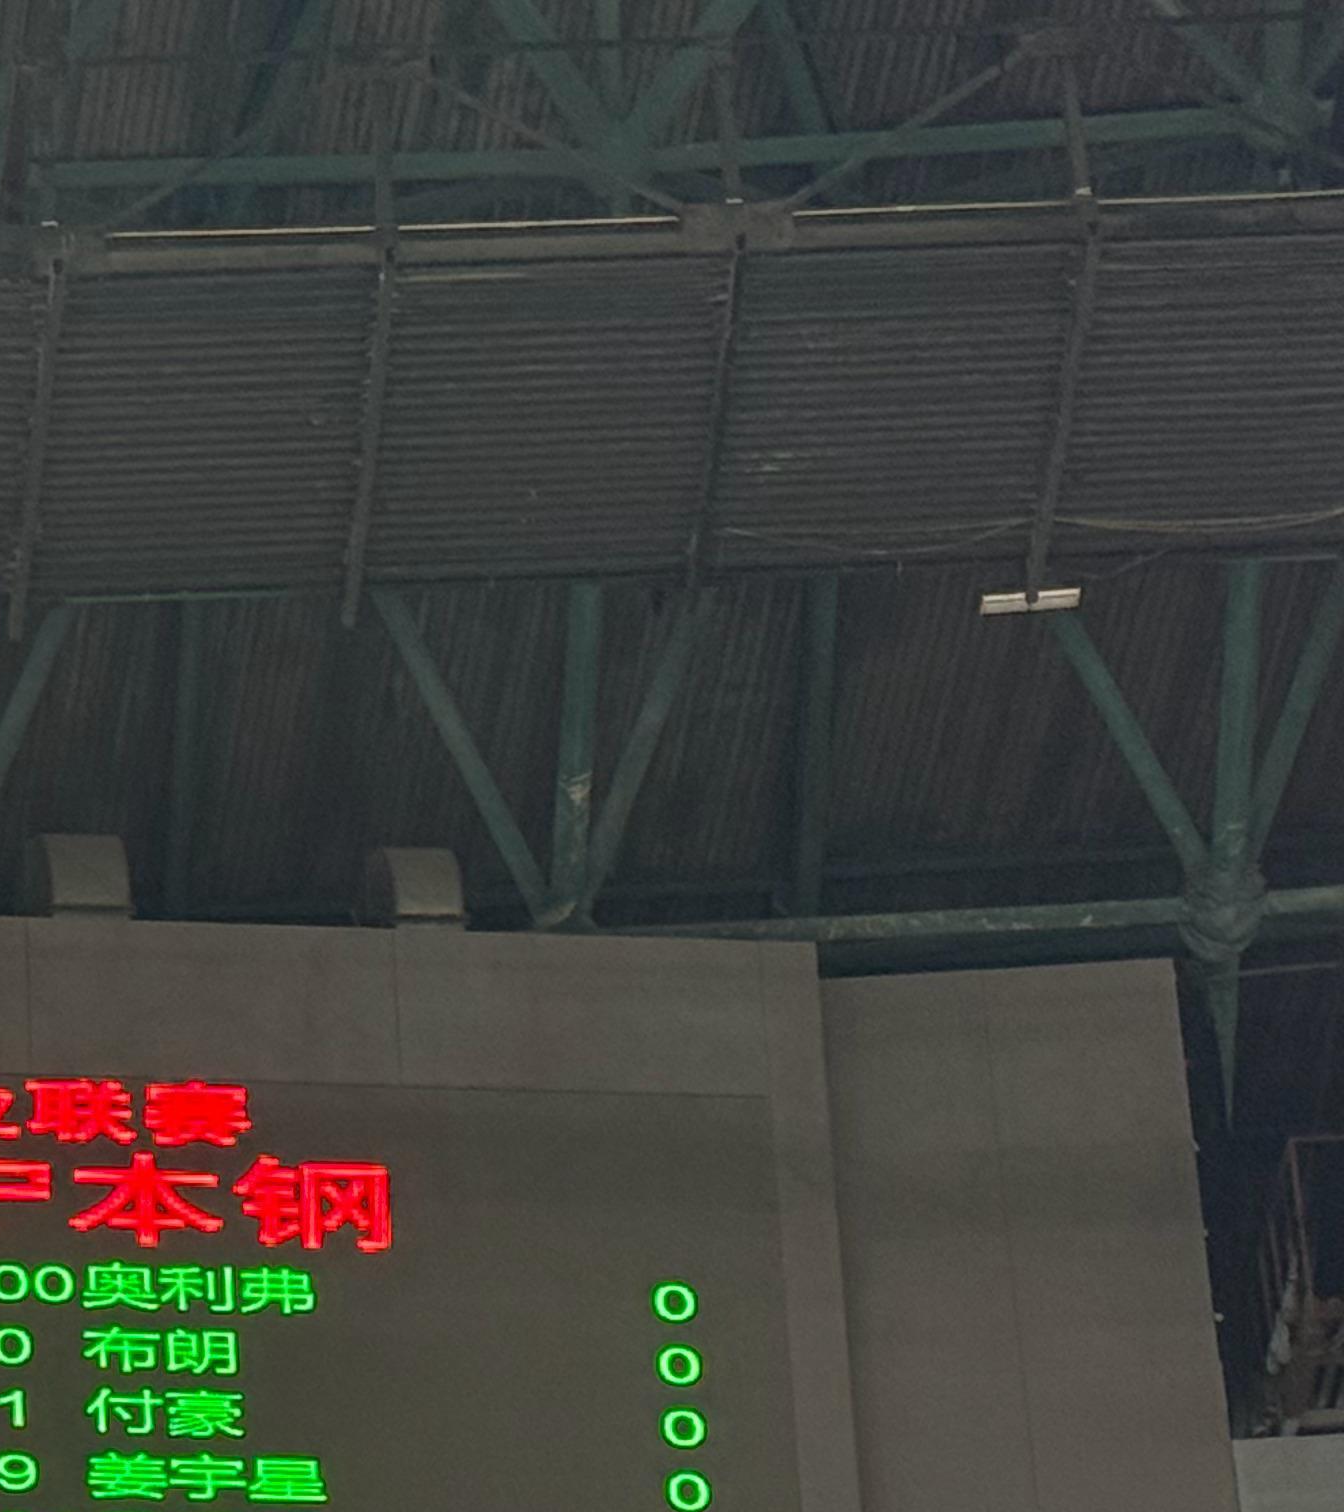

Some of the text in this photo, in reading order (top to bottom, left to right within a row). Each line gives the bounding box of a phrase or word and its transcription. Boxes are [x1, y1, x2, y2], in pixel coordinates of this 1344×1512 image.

[652, 1281, 696, 1323] 0
[83, 1324, 238, 1376] 布朗
[657, 1344, 701, 1386] 0
[86, 1386, 243, 1438] 付豪
[660, 1407, 706, 1448] 0
[86, 1450, 327, 1503] 姜宇星
[665, 1470, 710, 1512] 0
